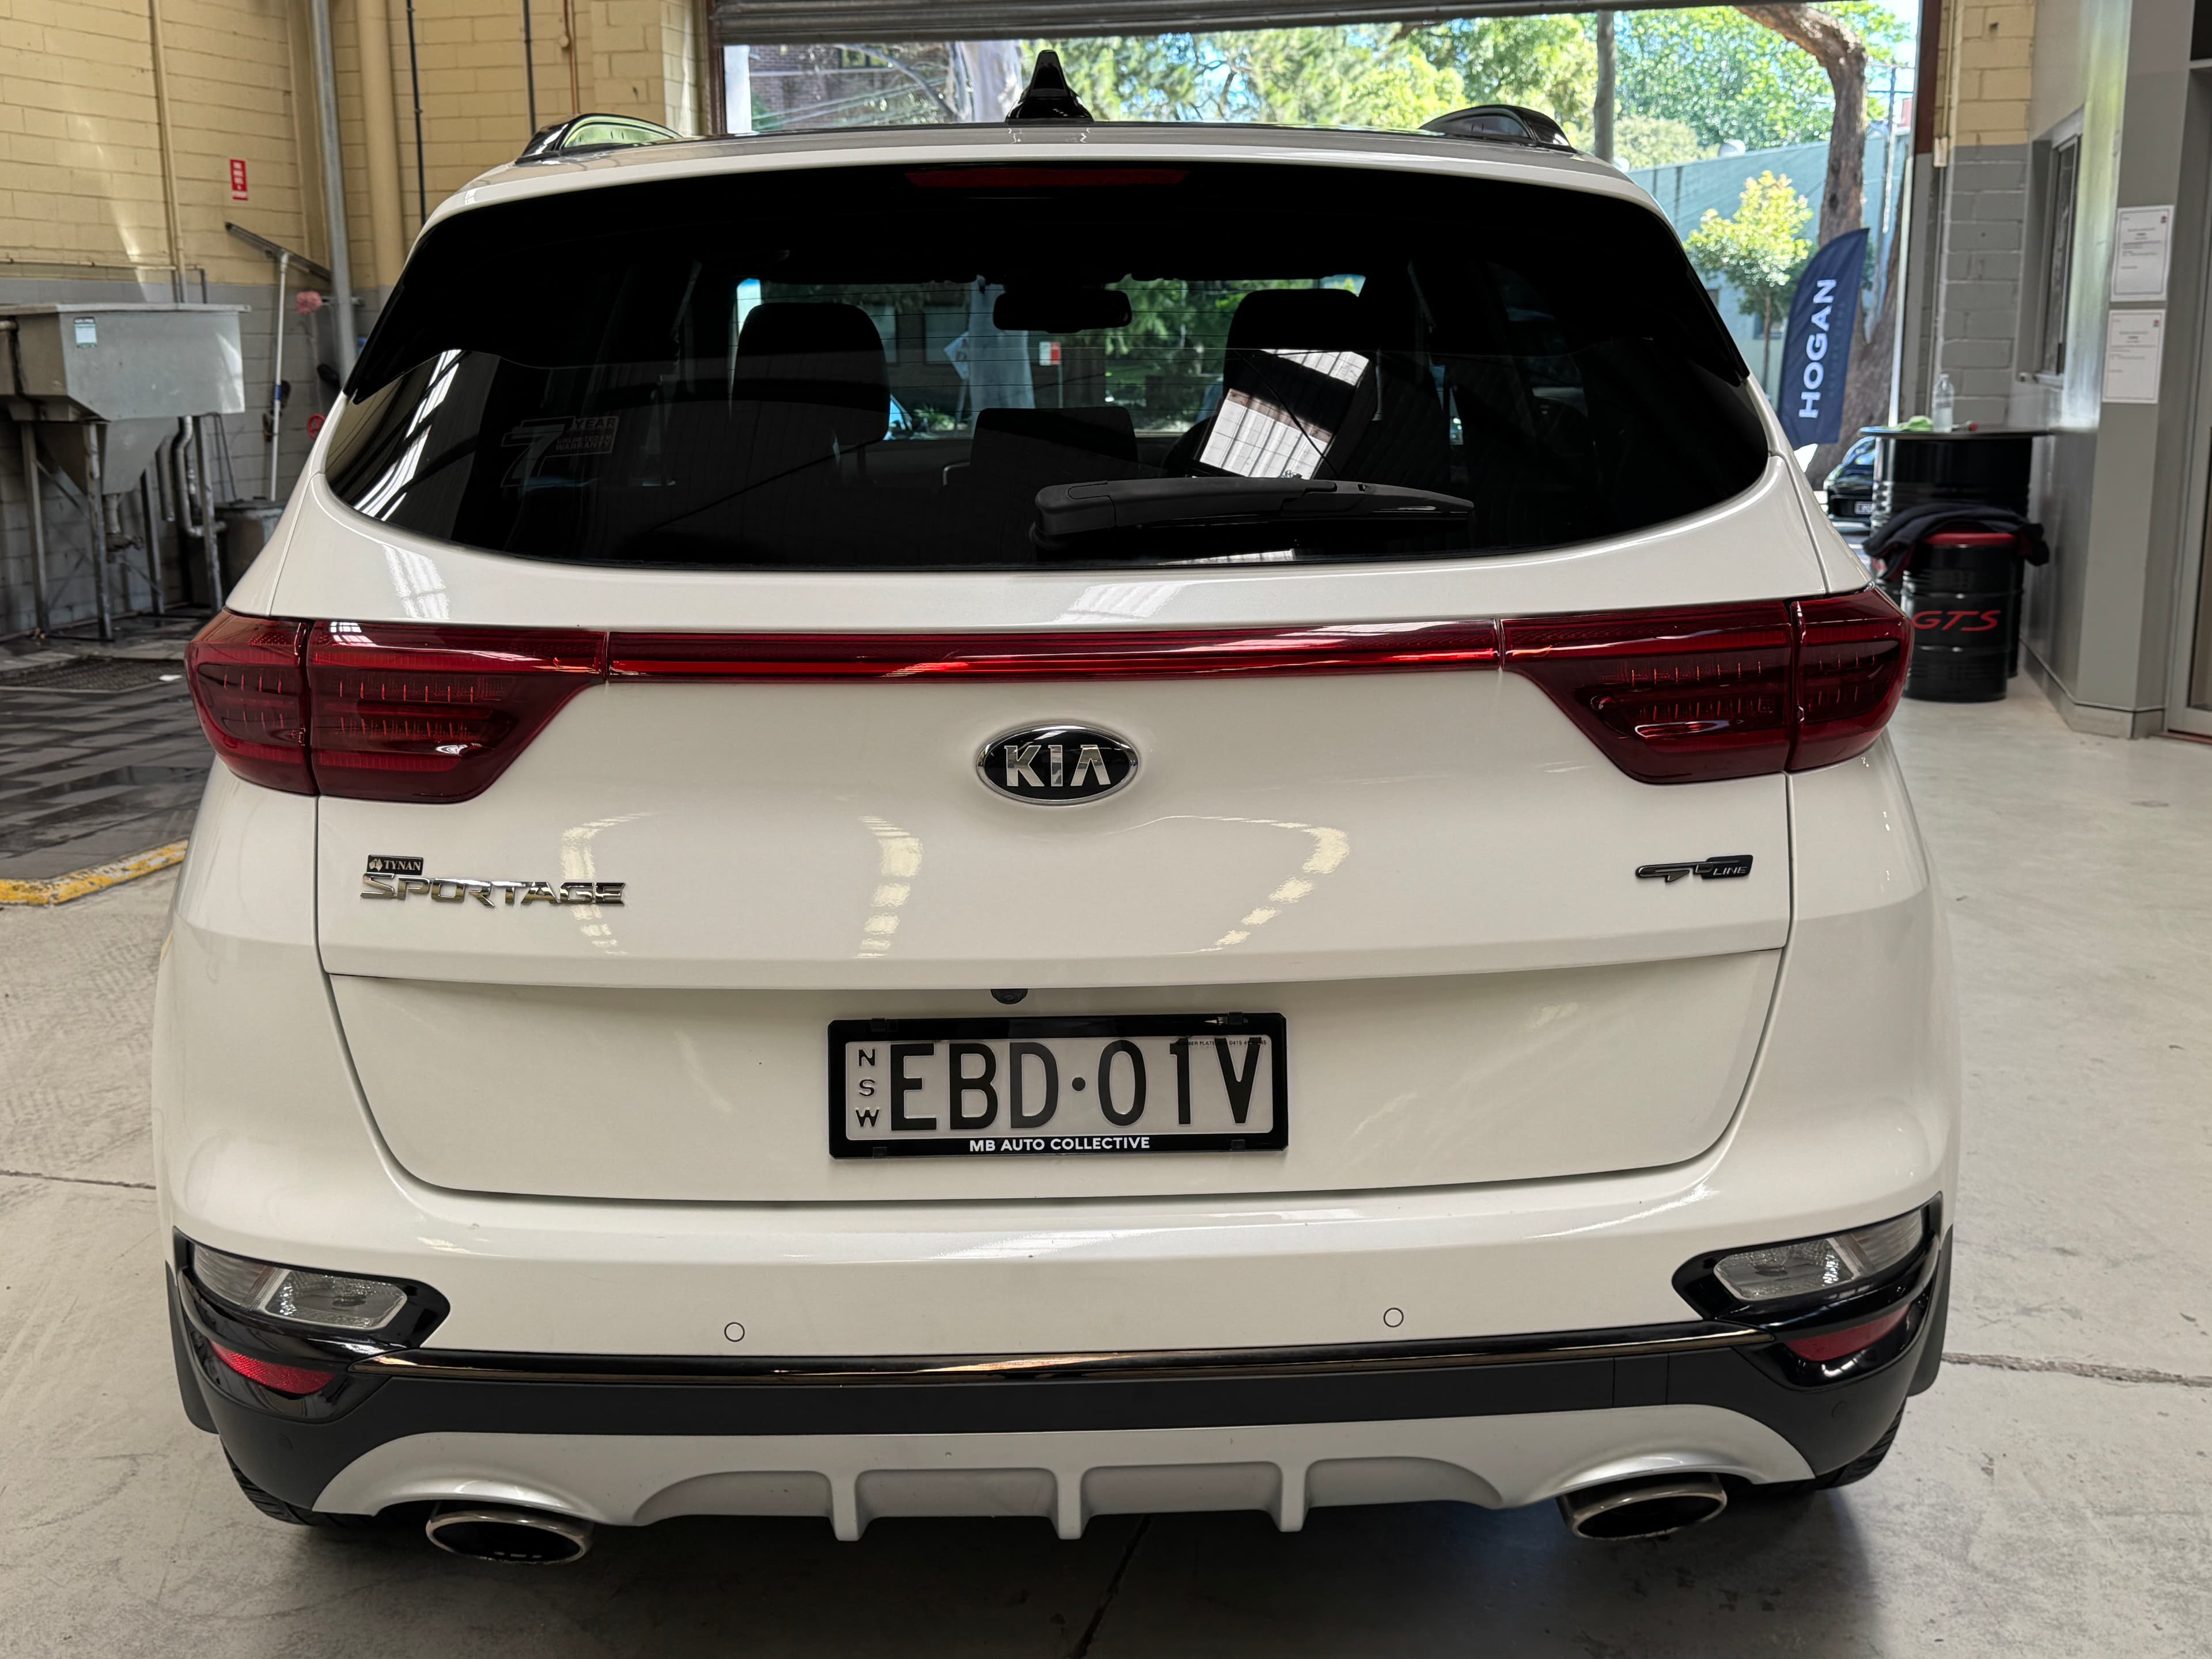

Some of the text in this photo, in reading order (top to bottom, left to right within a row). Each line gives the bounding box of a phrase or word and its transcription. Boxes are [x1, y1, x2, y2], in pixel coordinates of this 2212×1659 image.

[1798, 278, 1837, 419] HOGAN
[575, 418, 615, 430] YEAR
[1912, 609, 2001, 631] GTS
[1004, 744, 1111, 787] KIA
[384, 860, 421, 871] TYNAN
[1713, 866, 1748, 876] LINE
[360, 873, 626, 908] SPORTAGE
[969, 1137, 1150, 1152] MB AUTO COLLECTIVE
